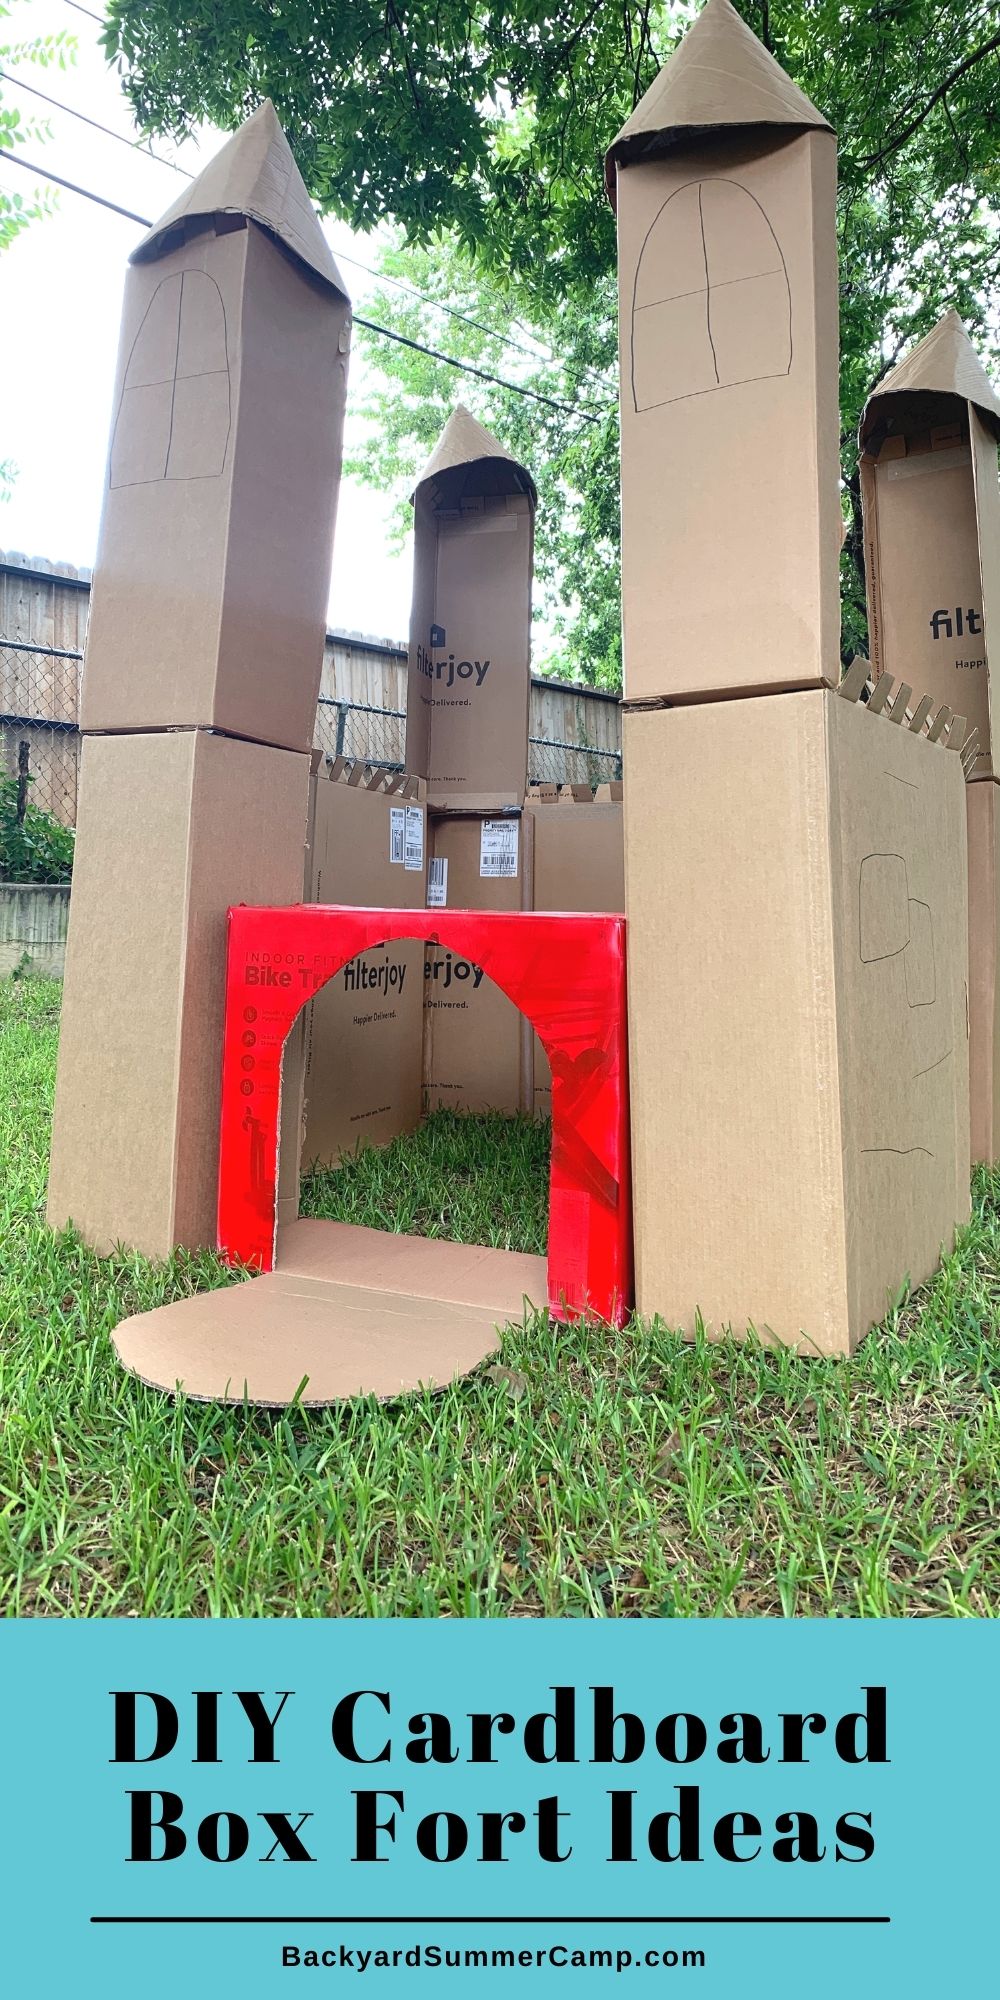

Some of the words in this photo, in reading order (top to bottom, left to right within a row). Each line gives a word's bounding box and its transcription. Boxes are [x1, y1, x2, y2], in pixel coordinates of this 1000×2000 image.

[417, 644, 490, 687] filterjoy
[484, 820, 491, 828] P
[245, 951, 305, 964] INDOOR
[245, 965, 292, 988] Bike
[343, 956, 406, 996] filterjoy
[427, 1000, 469, 1009] Delivered.
[353, 1014, 373, 1027] Happier
[374, 1010, 397, 1021] Delivered.
